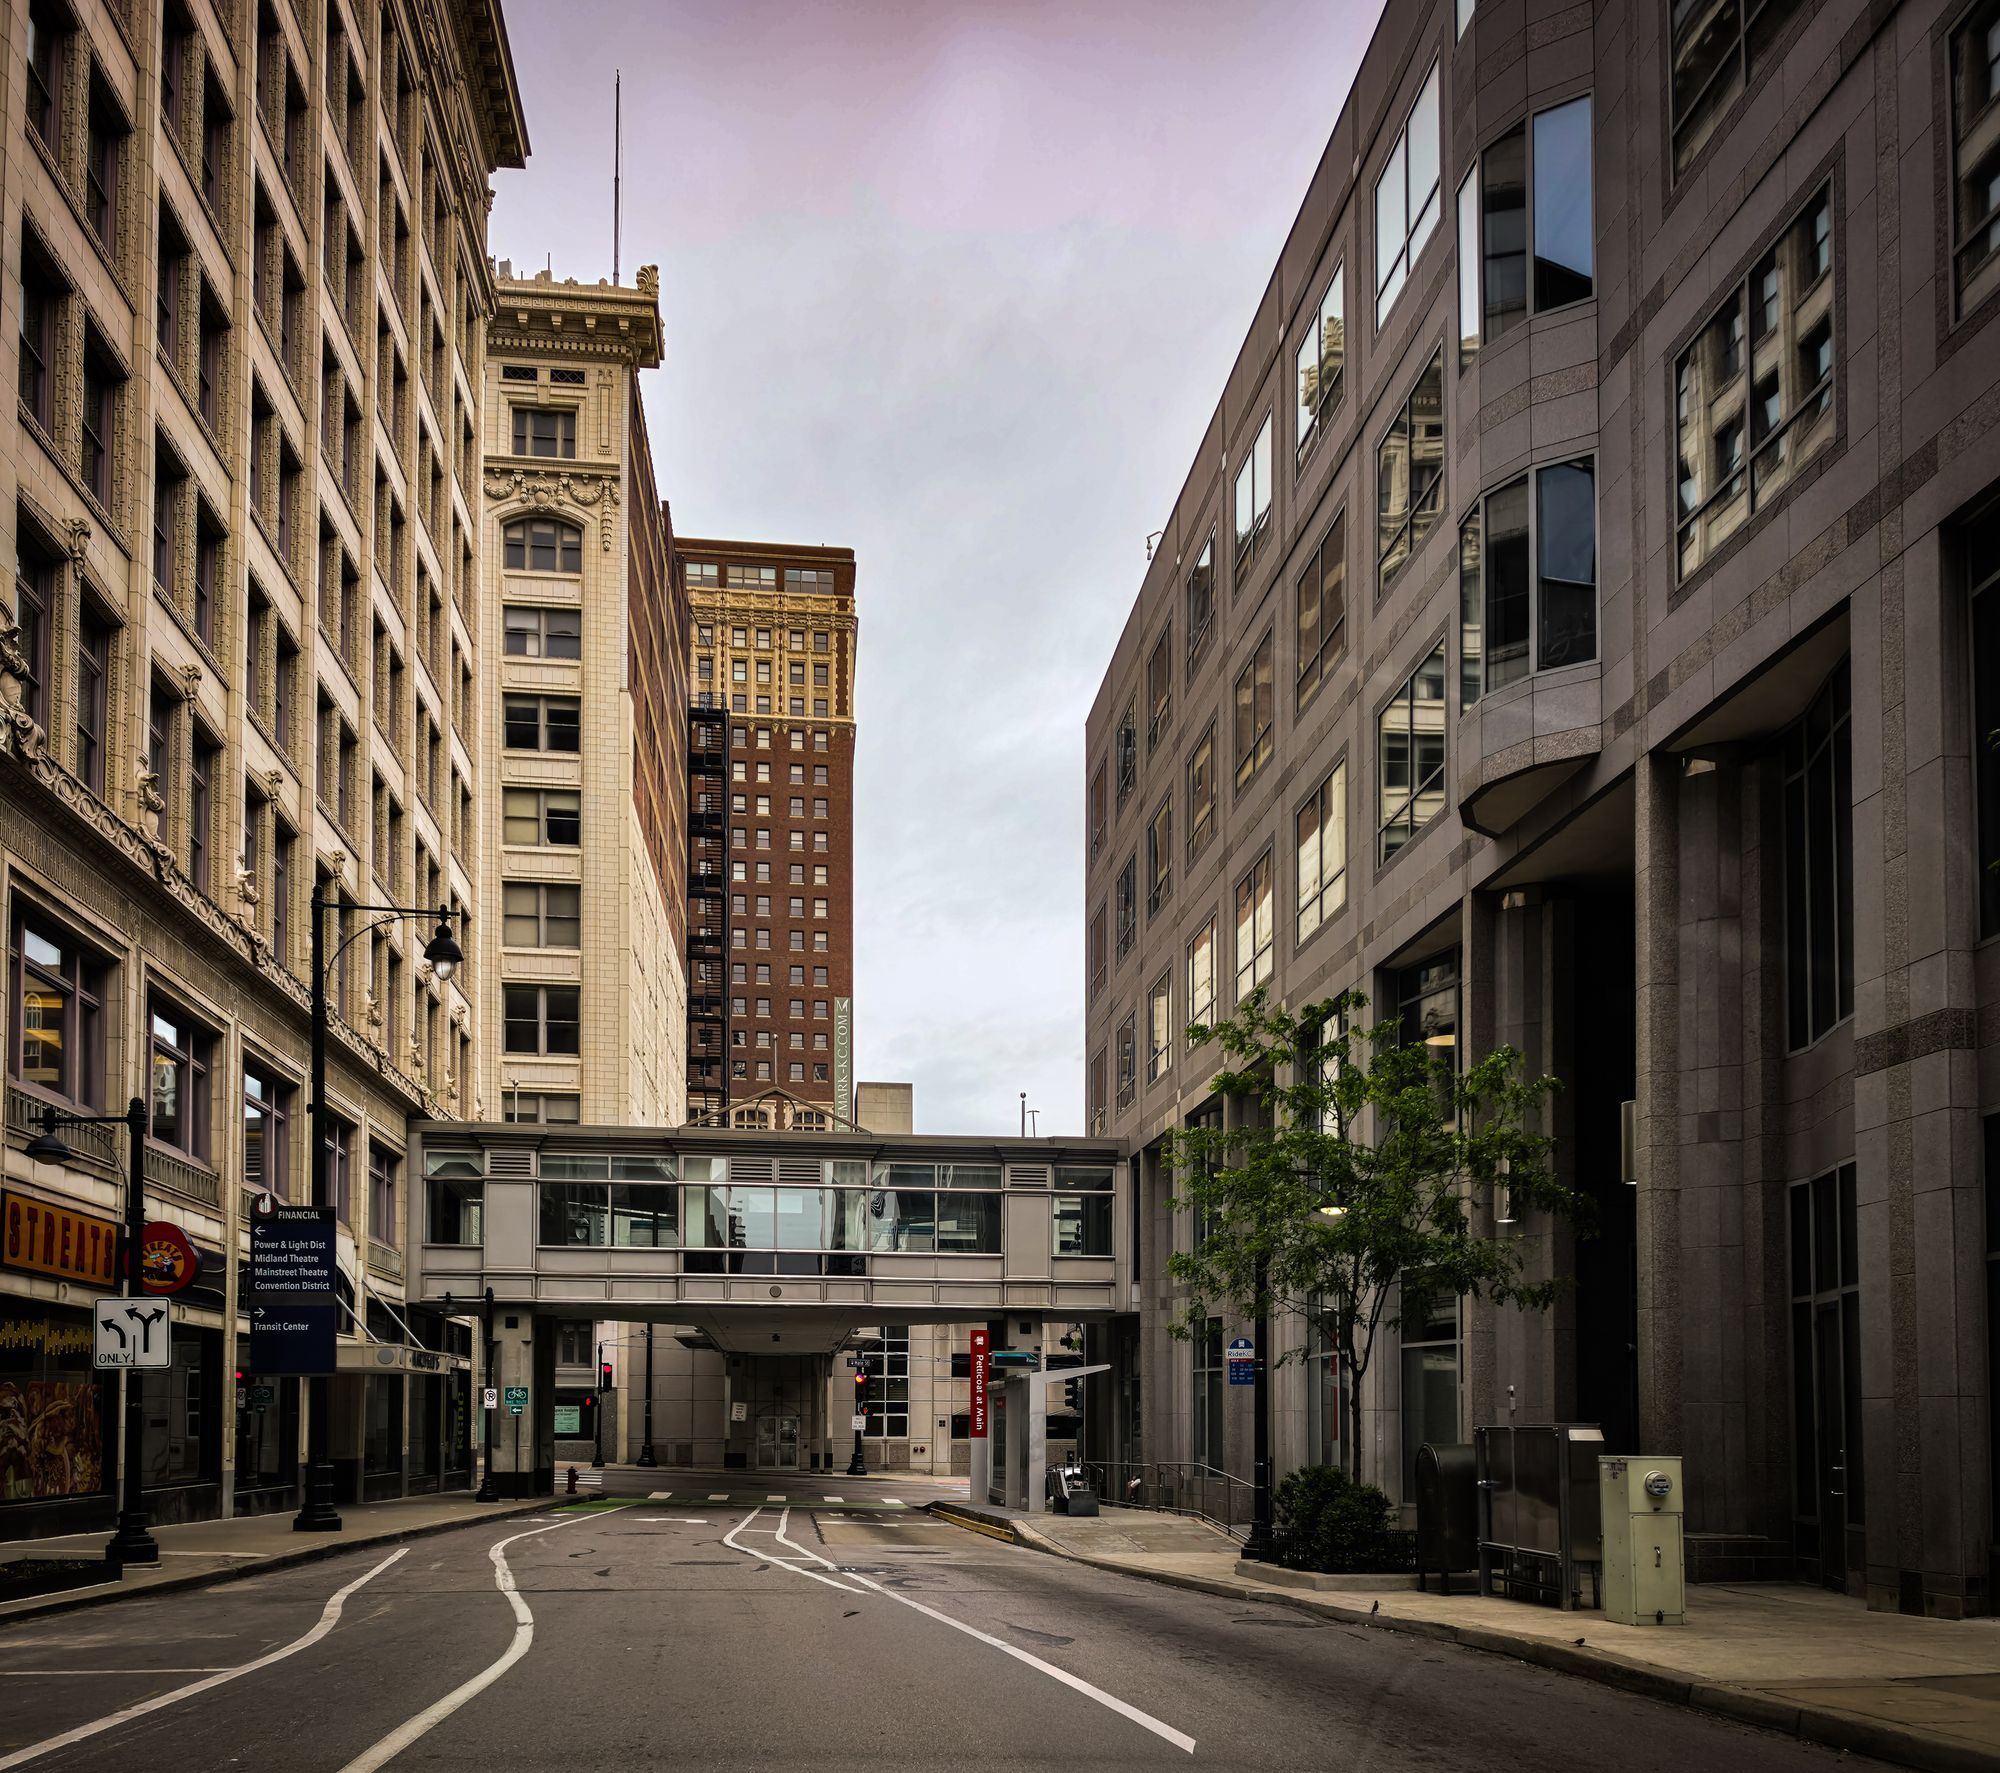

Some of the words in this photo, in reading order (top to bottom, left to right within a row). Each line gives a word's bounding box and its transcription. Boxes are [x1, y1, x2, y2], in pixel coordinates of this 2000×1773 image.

[837, 1015, 849, 1131] HEMARK-KC.COM
[278, 1211, 320, 1220] FINANCIAL
[9, 1202, 113, 1278] STREATS
[254, 1240, 279, 1249] Power
[280, 1240, 287, 1249] &
[288, 1240, 309, 1251] Light
[310, 1240, 326, 1249] Dist
[254, 1254, 288, 1263] Midland
[289, 1254, 319, 1263] Theatre
[254, 1267, 298, 1277] Mainstreet
[298, 1268, 329, 1277] Theatre
[254, 1281, 301, 1290] Convention
[301, 1281, 330, 1290] District
[254, 1322, 282, 1331] Transit
[282, 1322, 309, 1331] Center
[98, 1353, 131, 1364] ONLY
[1227, 1350, 1252, 1358] RideKC
[975, 1354, 985, 1393] Petticoat
[975, 1394, 984, 1404] at
[975, 1407, 984, 1431] Main
